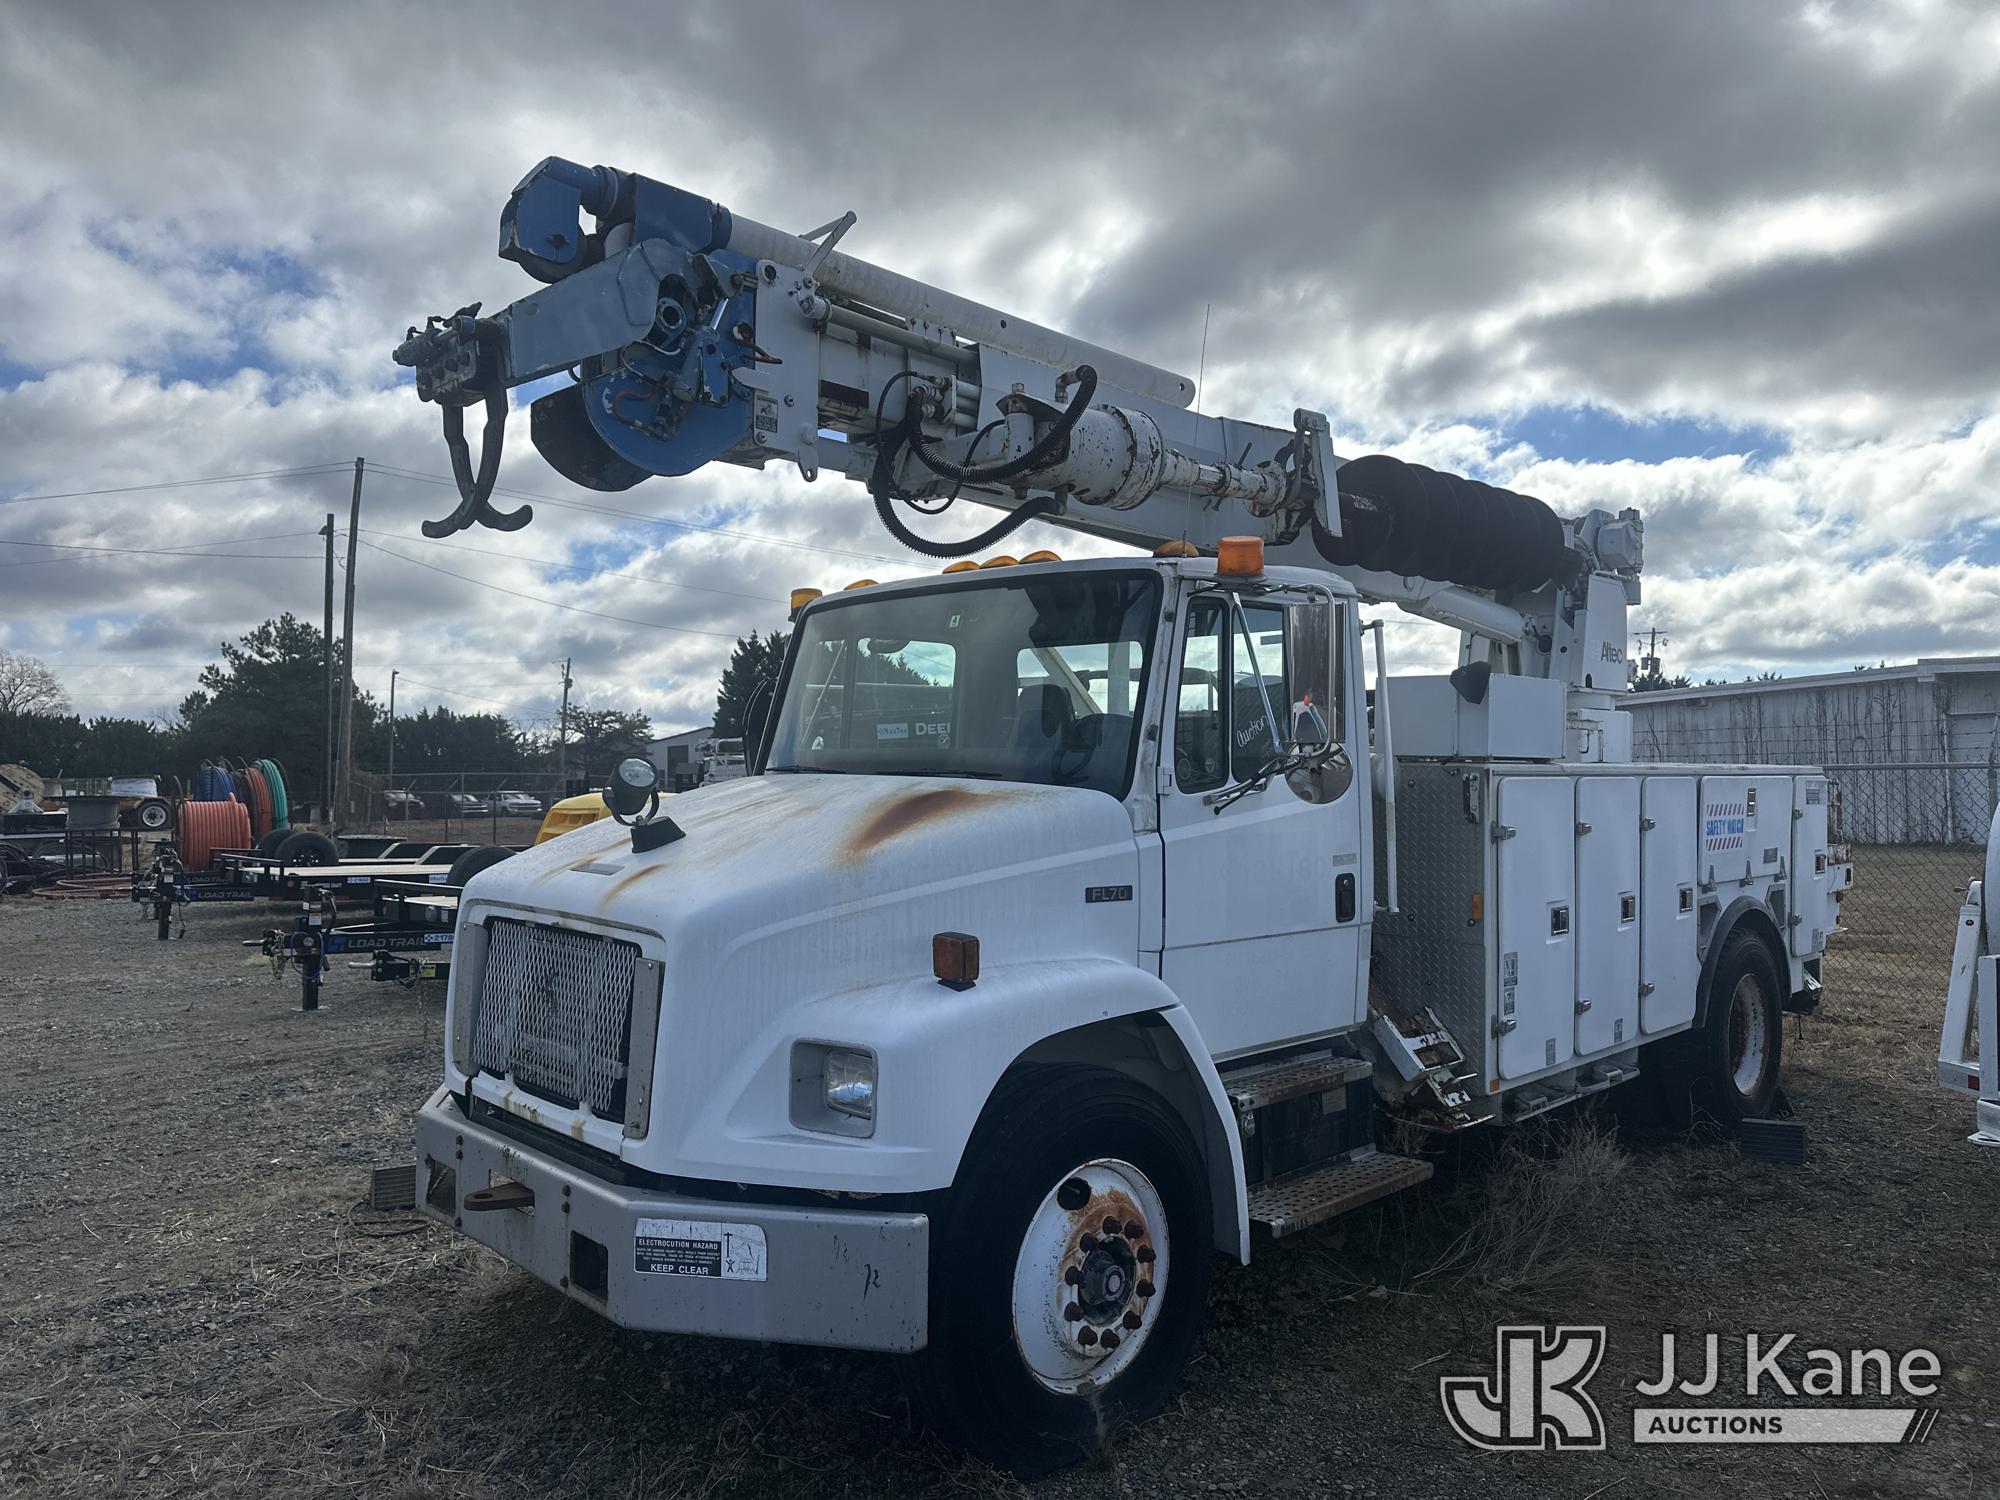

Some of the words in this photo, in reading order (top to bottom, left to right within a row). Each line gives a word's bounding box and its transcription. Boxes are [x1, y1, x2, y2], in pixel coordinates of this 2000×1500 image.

[1601, 641, 1622, 664] Altec
[1706, 819, 1726, 836] SAFETY
[1092, 887, 1129, 901] FL70
[639, 1239, 690, 1249] ELECTROCUTION
[693, 1242, 718, 1250] HAZARD
[650, 1263, 674, 1273] KEEP
[678, 1265, 709, 1275] CLEAR
